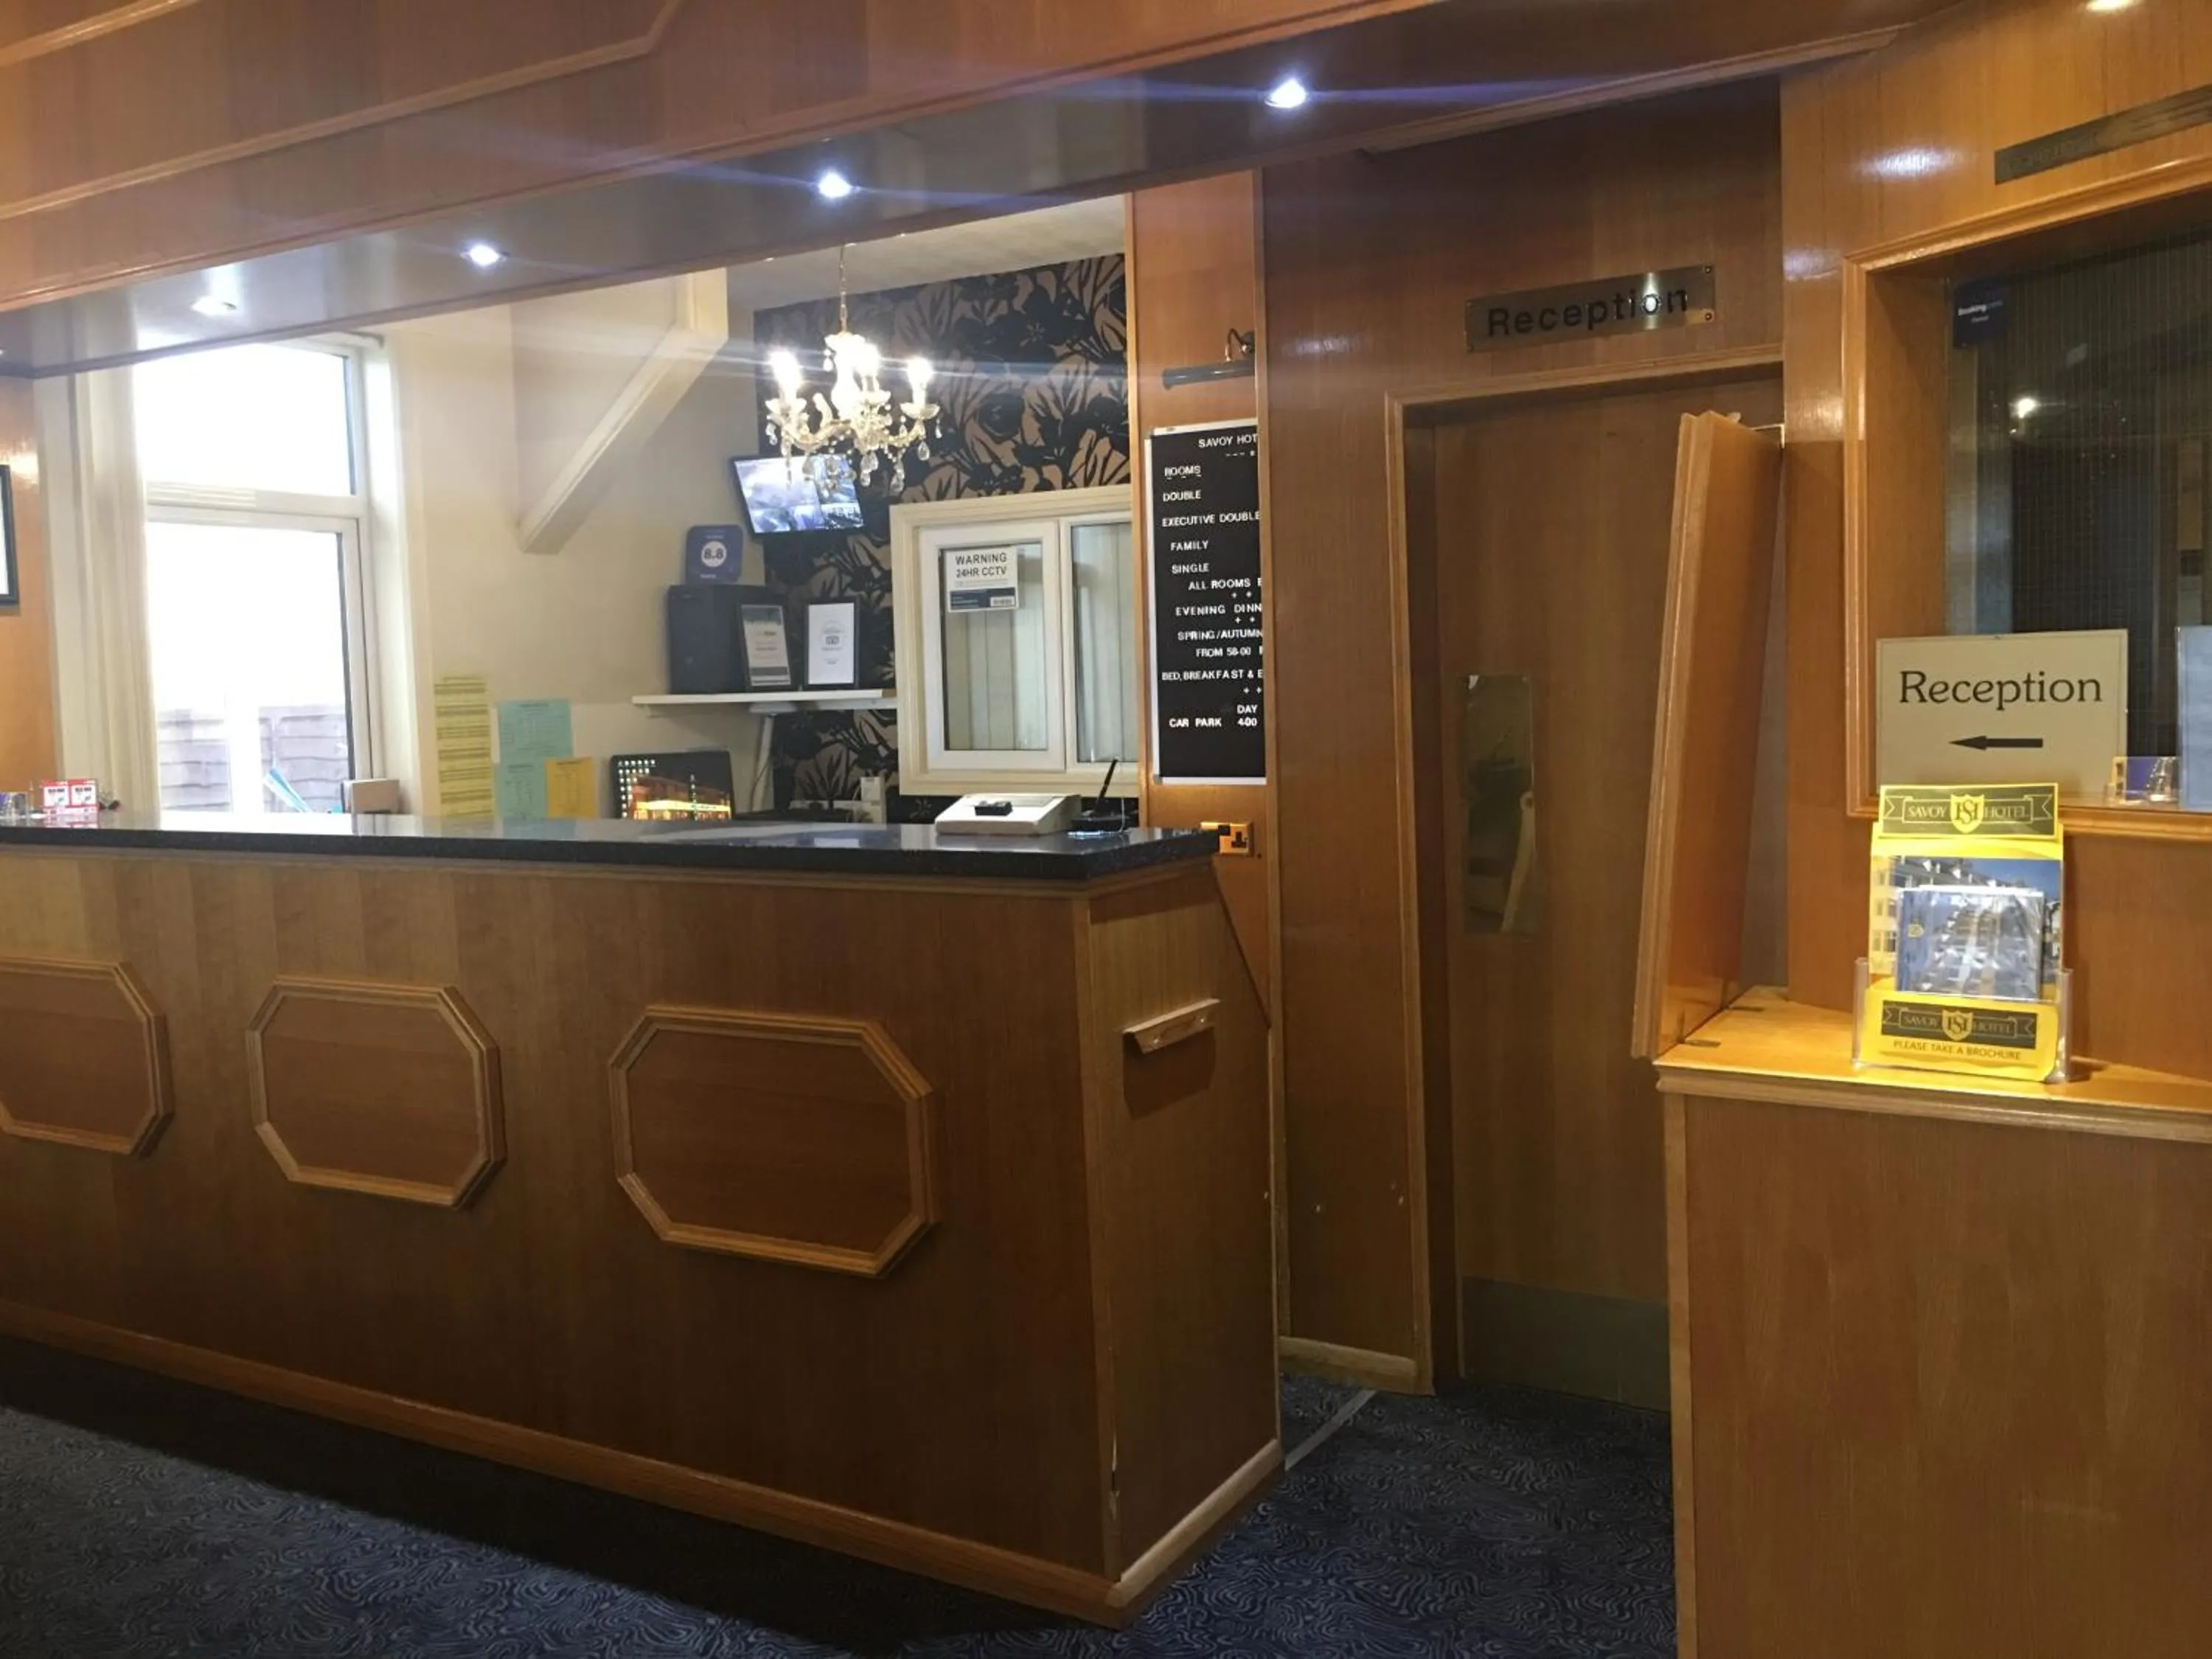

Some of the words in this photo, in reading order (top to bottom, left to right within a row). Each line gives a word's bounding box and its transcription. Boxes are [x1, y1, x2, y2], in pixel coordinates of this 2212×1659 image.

[1486, 288, 1688, 337] Reception
[1198, 436, 1234, 448] SAVOY
[1164, 465, 1201, 477] ROOMS
[1163, 490, 1202, 502] DOUBLE
[1162, 514, 1215, 527] EXECUTIVE
[1219, 511, 1260, 523] DOUBLE
[1170, 540, 1209, 551] FAMILY
[955, 552, 1006, 566] WARNING
[981, 566, 1006, 577] CCTV
[1172, 563, 1210, 574] SINGLE
[1188, 580, 1208, 591] ALL
[1211, 578, 1251, 590] ROOMS
[1175, 605, 1226, 616] EVENING
[1195, 647, 1223, 658] FROM
[1899, 670, 2101, 710] Reception
[1237, 704, 1258, 714] DAY
[1169, 717, 1189, 728] CAR
[1195, 717, 1222, 728] PARK
[1907, 805, 1947, 818] SAVOY
[1983, 805, 2028, 818] HOTEL
[1893, 1040, 1927, 1051] PLEASE
[1930, 1043, 1954, 1054] TAKE
[1956, 1046, 1964, 1054] A
[1966, 1046, 2022, 1060] BROCHURE
